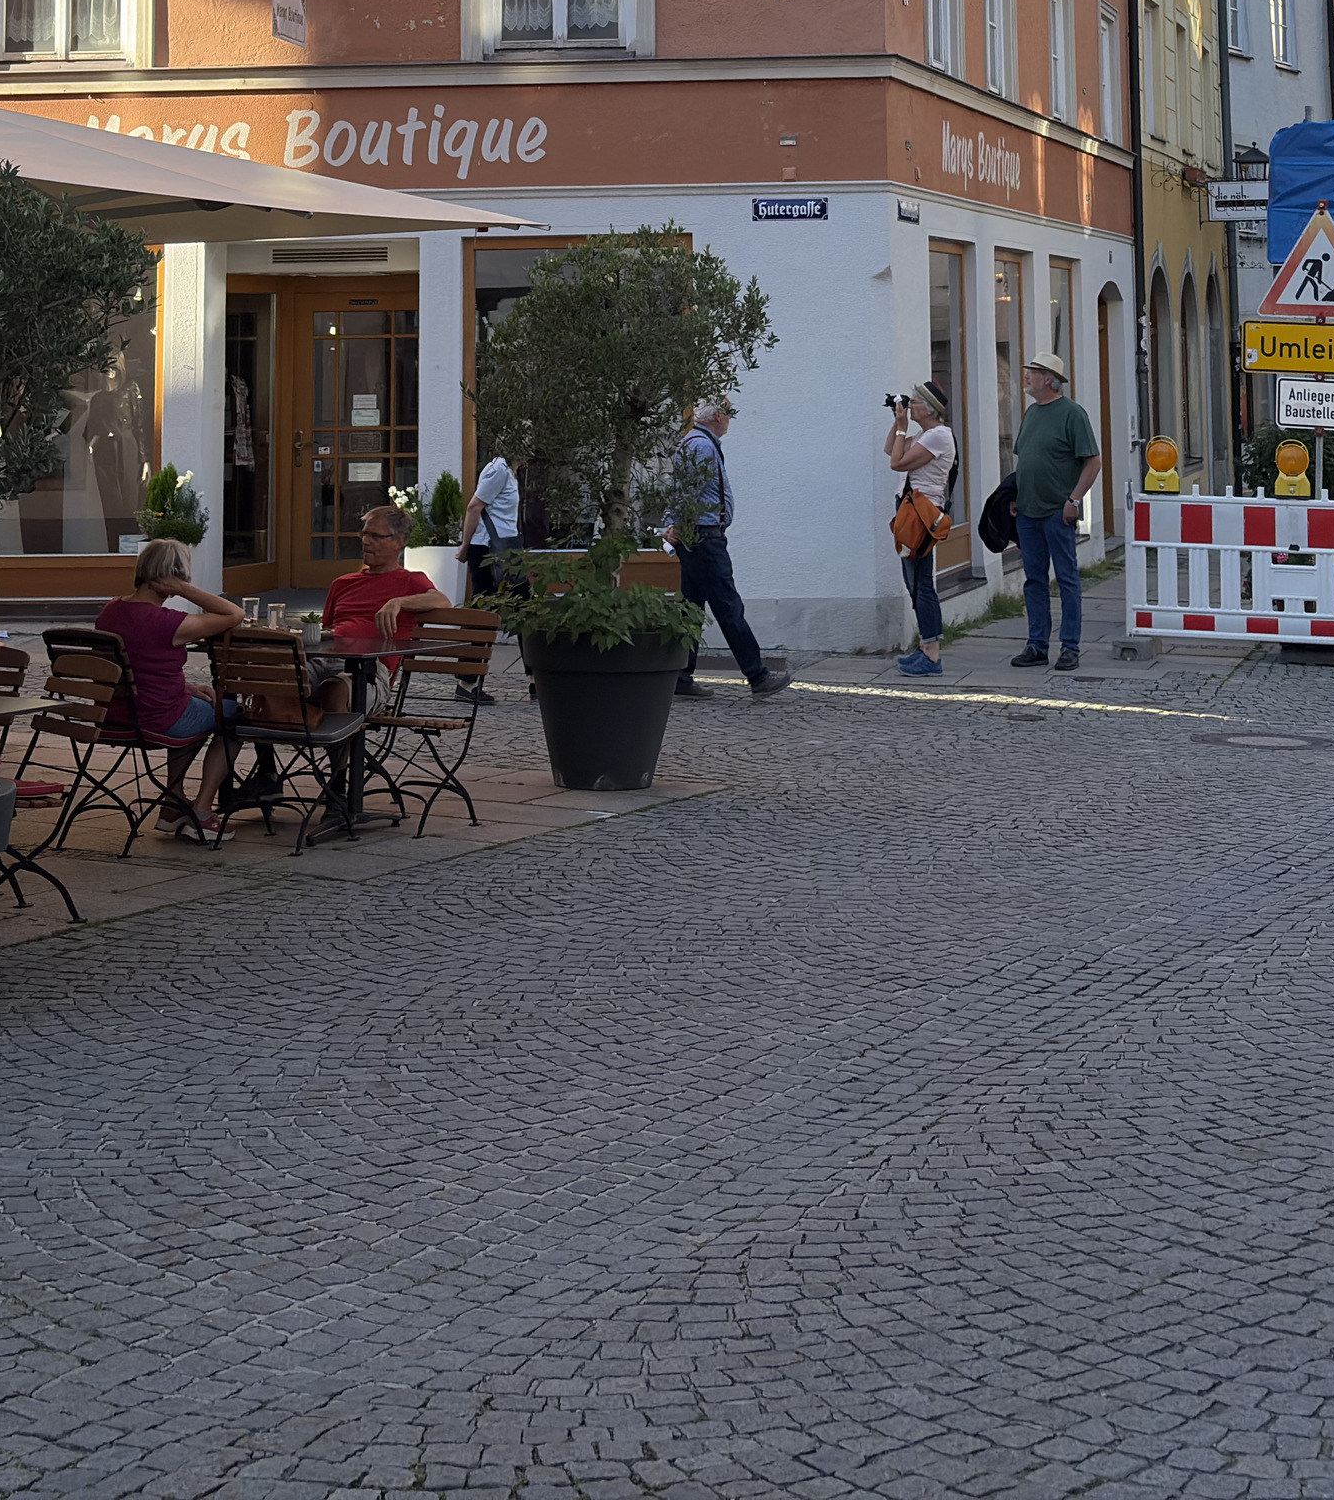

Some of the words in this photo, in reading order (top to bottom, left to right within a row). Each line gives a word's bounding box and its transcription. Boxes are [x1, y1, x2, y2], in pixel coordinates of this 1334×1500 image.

[282, 104, 548, 180] Boutique
[942, 121, 974, 191] Marys
[978, 132, 1021, 202] Boutique
[1215, 185, 1228, 200] die
[1230, 185, 1250, 200] näh-
